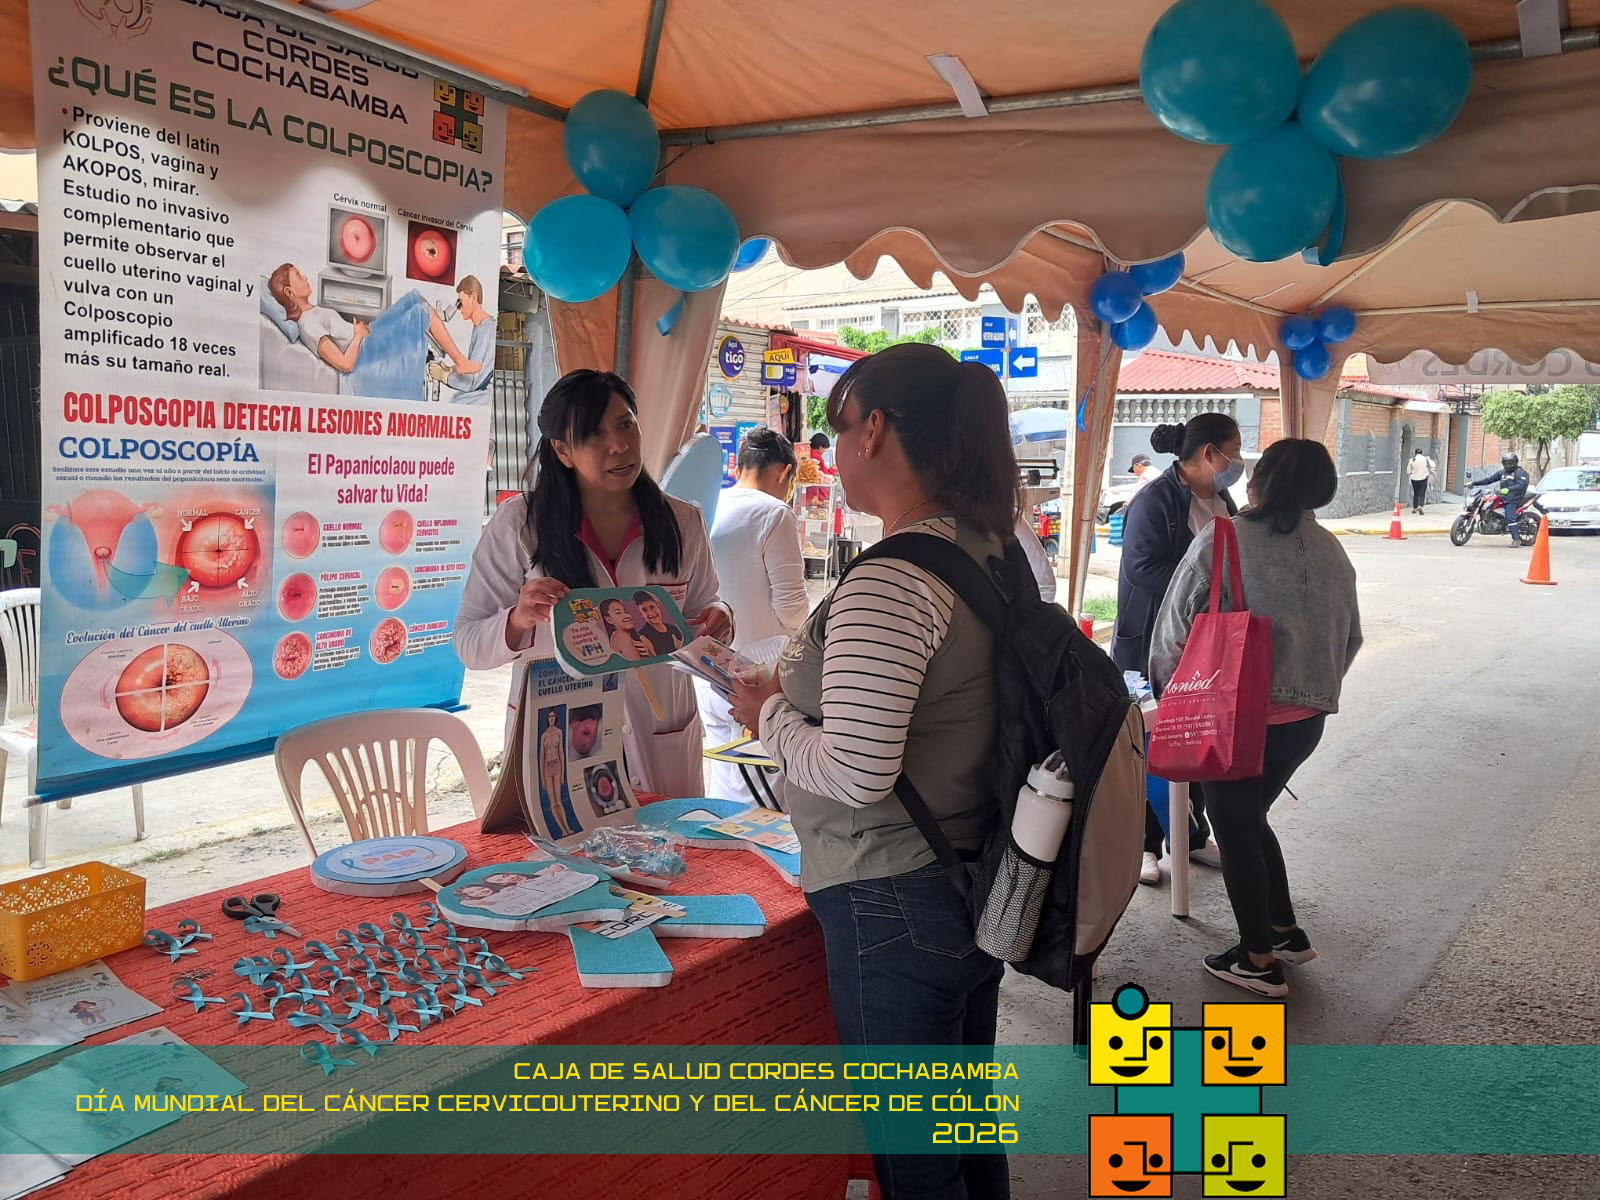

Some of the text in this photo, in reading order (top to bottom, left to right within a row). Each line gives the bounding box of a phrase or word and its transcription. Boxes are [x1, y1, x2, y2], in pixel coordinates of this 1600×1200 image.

[243, 30, 369, 86] CORDES
[192, 41, 408, 124] COCHABAMBA
[49, 56, 492, 193] ¿QUÉ ES LA COLPOSCOPIA?
[73, 106, 150, 138] Proviene
[156, 127, 180, 145] del
[63, 129, 218, 180] KOLPOS, vagina y
[63, 155, 199, 196] AKOPOS, mirar.
[64, 179, 229, 224] Estudio no invasivo
[361, 199, 387, 212] normal
[64, 207, 234, 248] complementario que
[64, 231, 225, 268] permite observar el
[64, 255, 254, 296] cuello uterino vaginal y
[64, 280, 173, 304] vulva con un
[64, 301, 173, 328] Colposcopio
[64, 328, 236, 356] amplificado 18 veces
[64, 350, 230, 377] más su tamaño real.
[64, 392, 472, 440] COLPOSCOPIA DETECTA LESIONES ANORMALES
[59, 436, 260, 462] COLPOSCOPÍA
[308, 453, 454, 479] El Papanicolaou puede
[337, 483, 429, 505] salvar tu Vida!
[120, 627, 135, 639] del
[173, 622, 188, 633] del
[538, 680, 593, 696] CUELLO UTERINO
